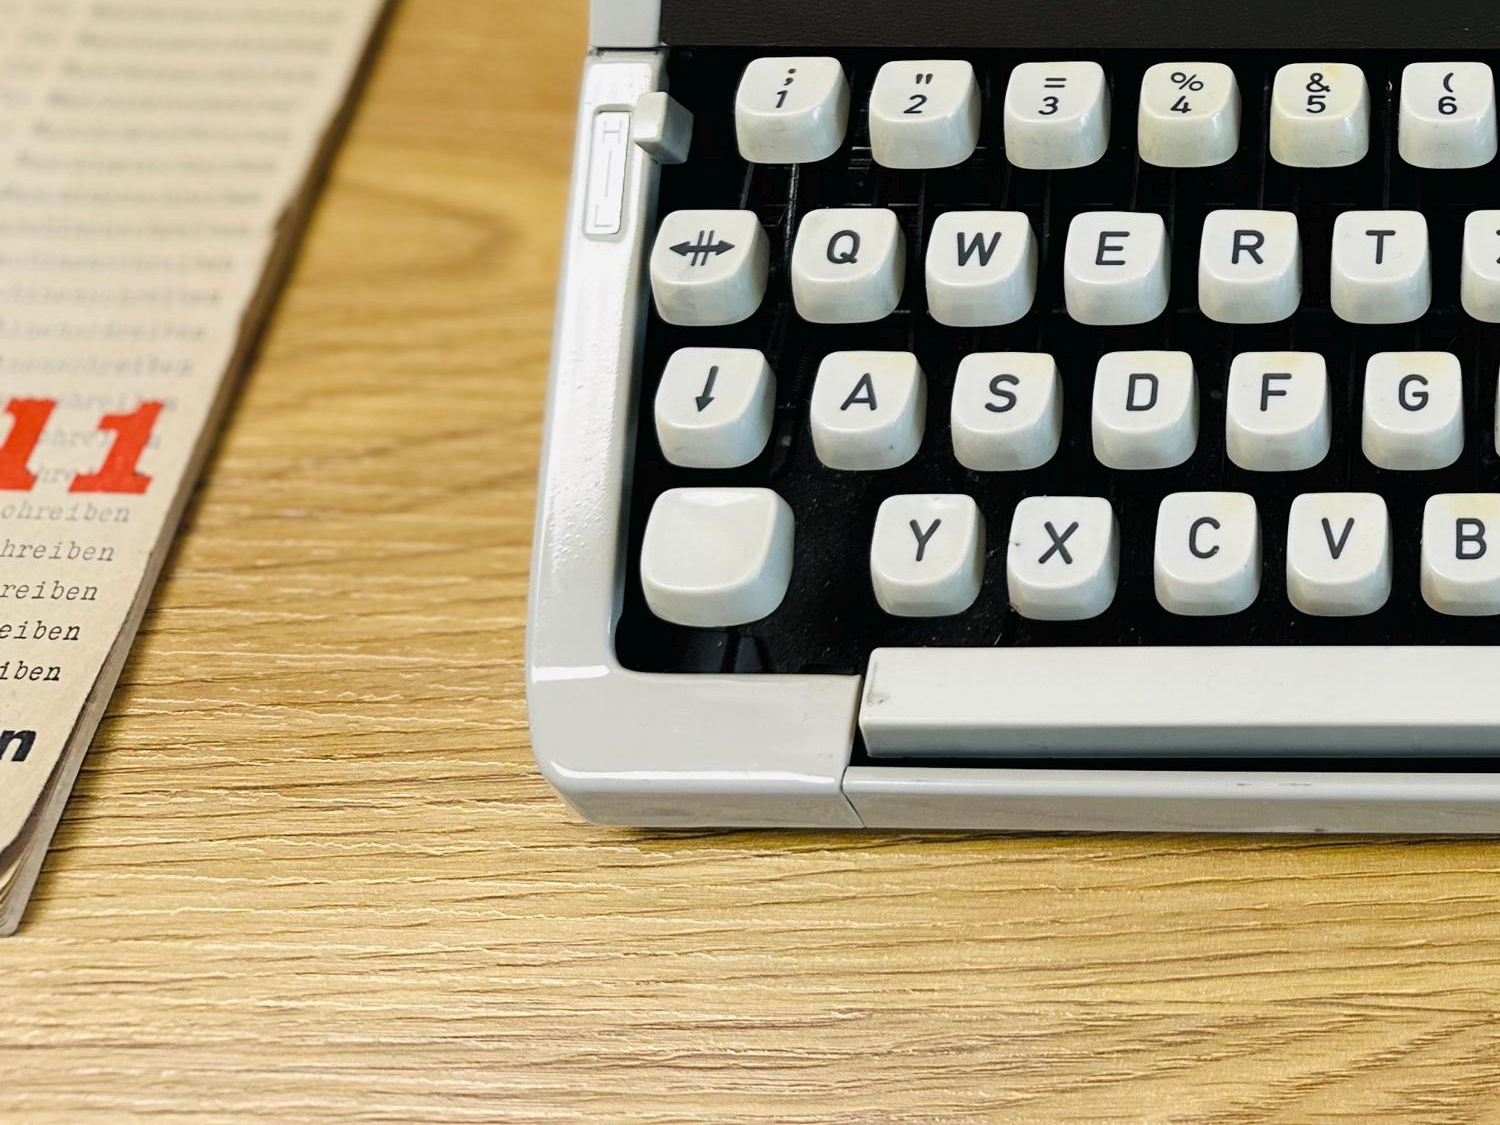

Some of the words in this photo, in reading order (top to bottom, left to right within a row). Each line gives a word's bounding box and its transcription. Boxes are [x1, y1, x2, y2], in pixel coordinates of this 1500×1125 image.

[775, 90, 788, 109] 1
[1043, 77, 1067, 89] =
[1170, 71, 1204, 92] %
[1305, 72, 1331, 93] &
[1442, 72, 1454, 93] (
[903, 94, 928, 114] 2
[1038, 96, 1059, 116] 3
[1170, 95, 1192, 114] 4
[1306, 94, 1326, 114] 5
[1438, 95, 1458, 116] 6
[826, 229, 861, 265] Q
[956, 231, 1002, 267] W
[1095, 230, 1130, 266] E
[1231, 229, 1265, 265] R
[1365, 229, 1396, 265] T
[840, 373, 878, 411] A
[984, 373, 1020, 413] S
[1125, 373, 1159, 412] D
[1259, 372, 1292, 412] F
[1398, 373, 1429, 412] G
[0, 539, 115, 562] hreiben
[909, 518, 942, 562] Y
[1038, 521, 1079, 565] X
[1188, 516, 1221, 559] C
[1321, 517, 1355, 560] V
[1455, 517, 1487, 560] B
[0, 621, 82, 642] eiben
